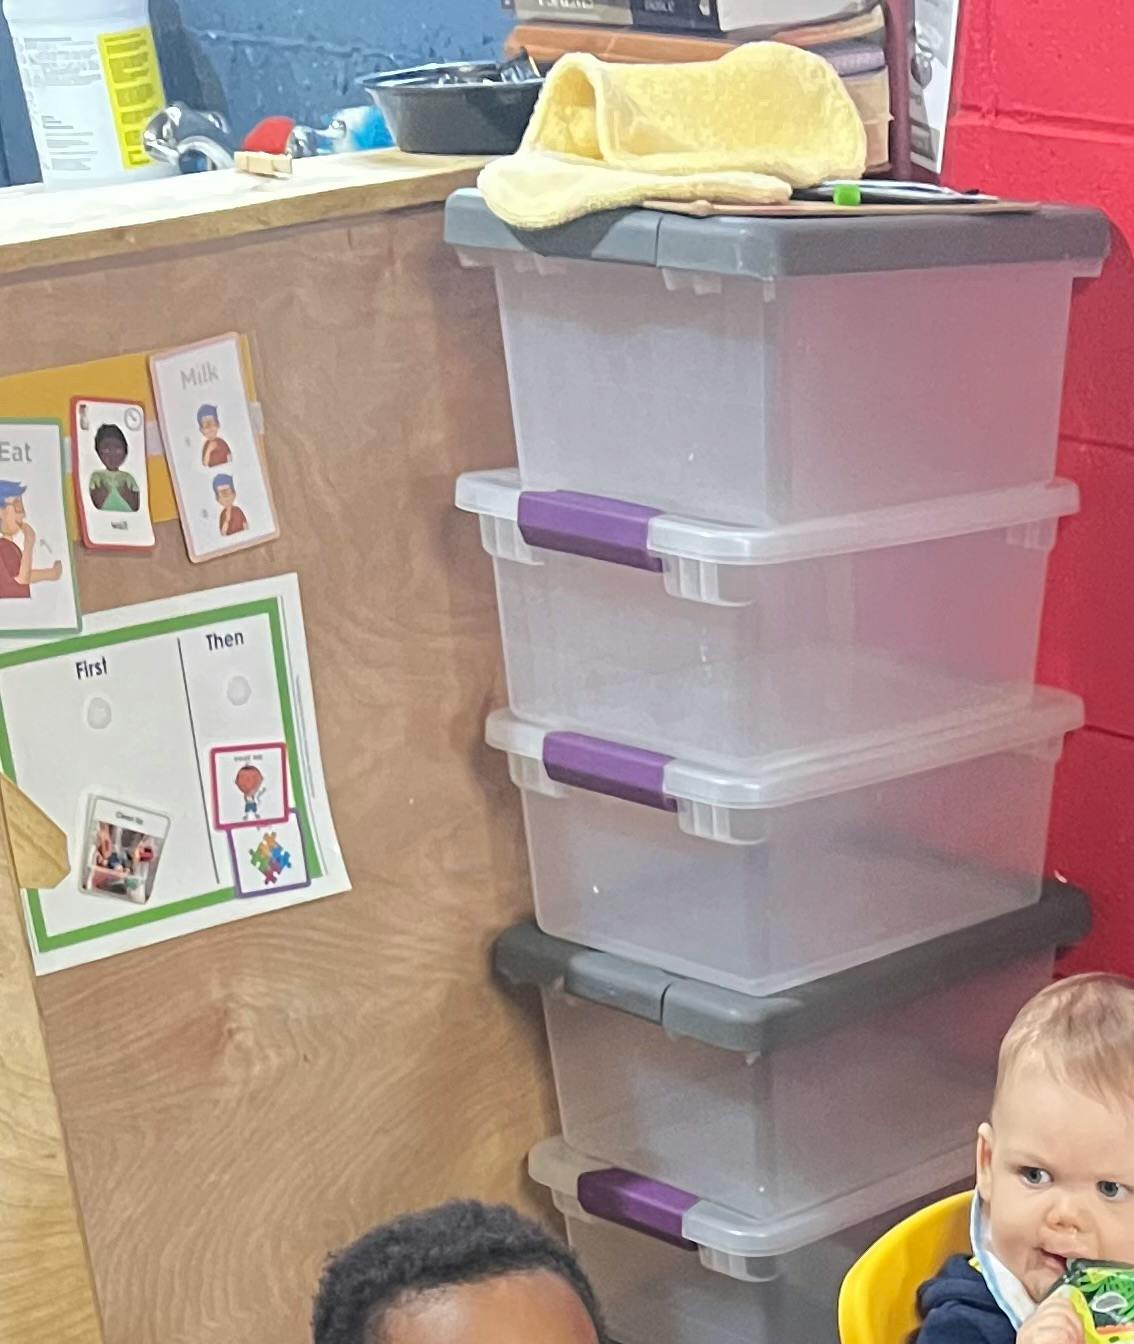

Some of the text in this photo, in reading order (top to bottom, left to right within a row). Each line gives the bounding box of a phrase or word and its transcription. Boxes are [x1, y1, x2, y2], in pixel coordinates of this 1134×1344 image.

[180, 361, 220, 391] Milk
[0, 441, 33, 463] Eat
[206, 631, 245, 652] Then
[75, 656, 108, 680] First
